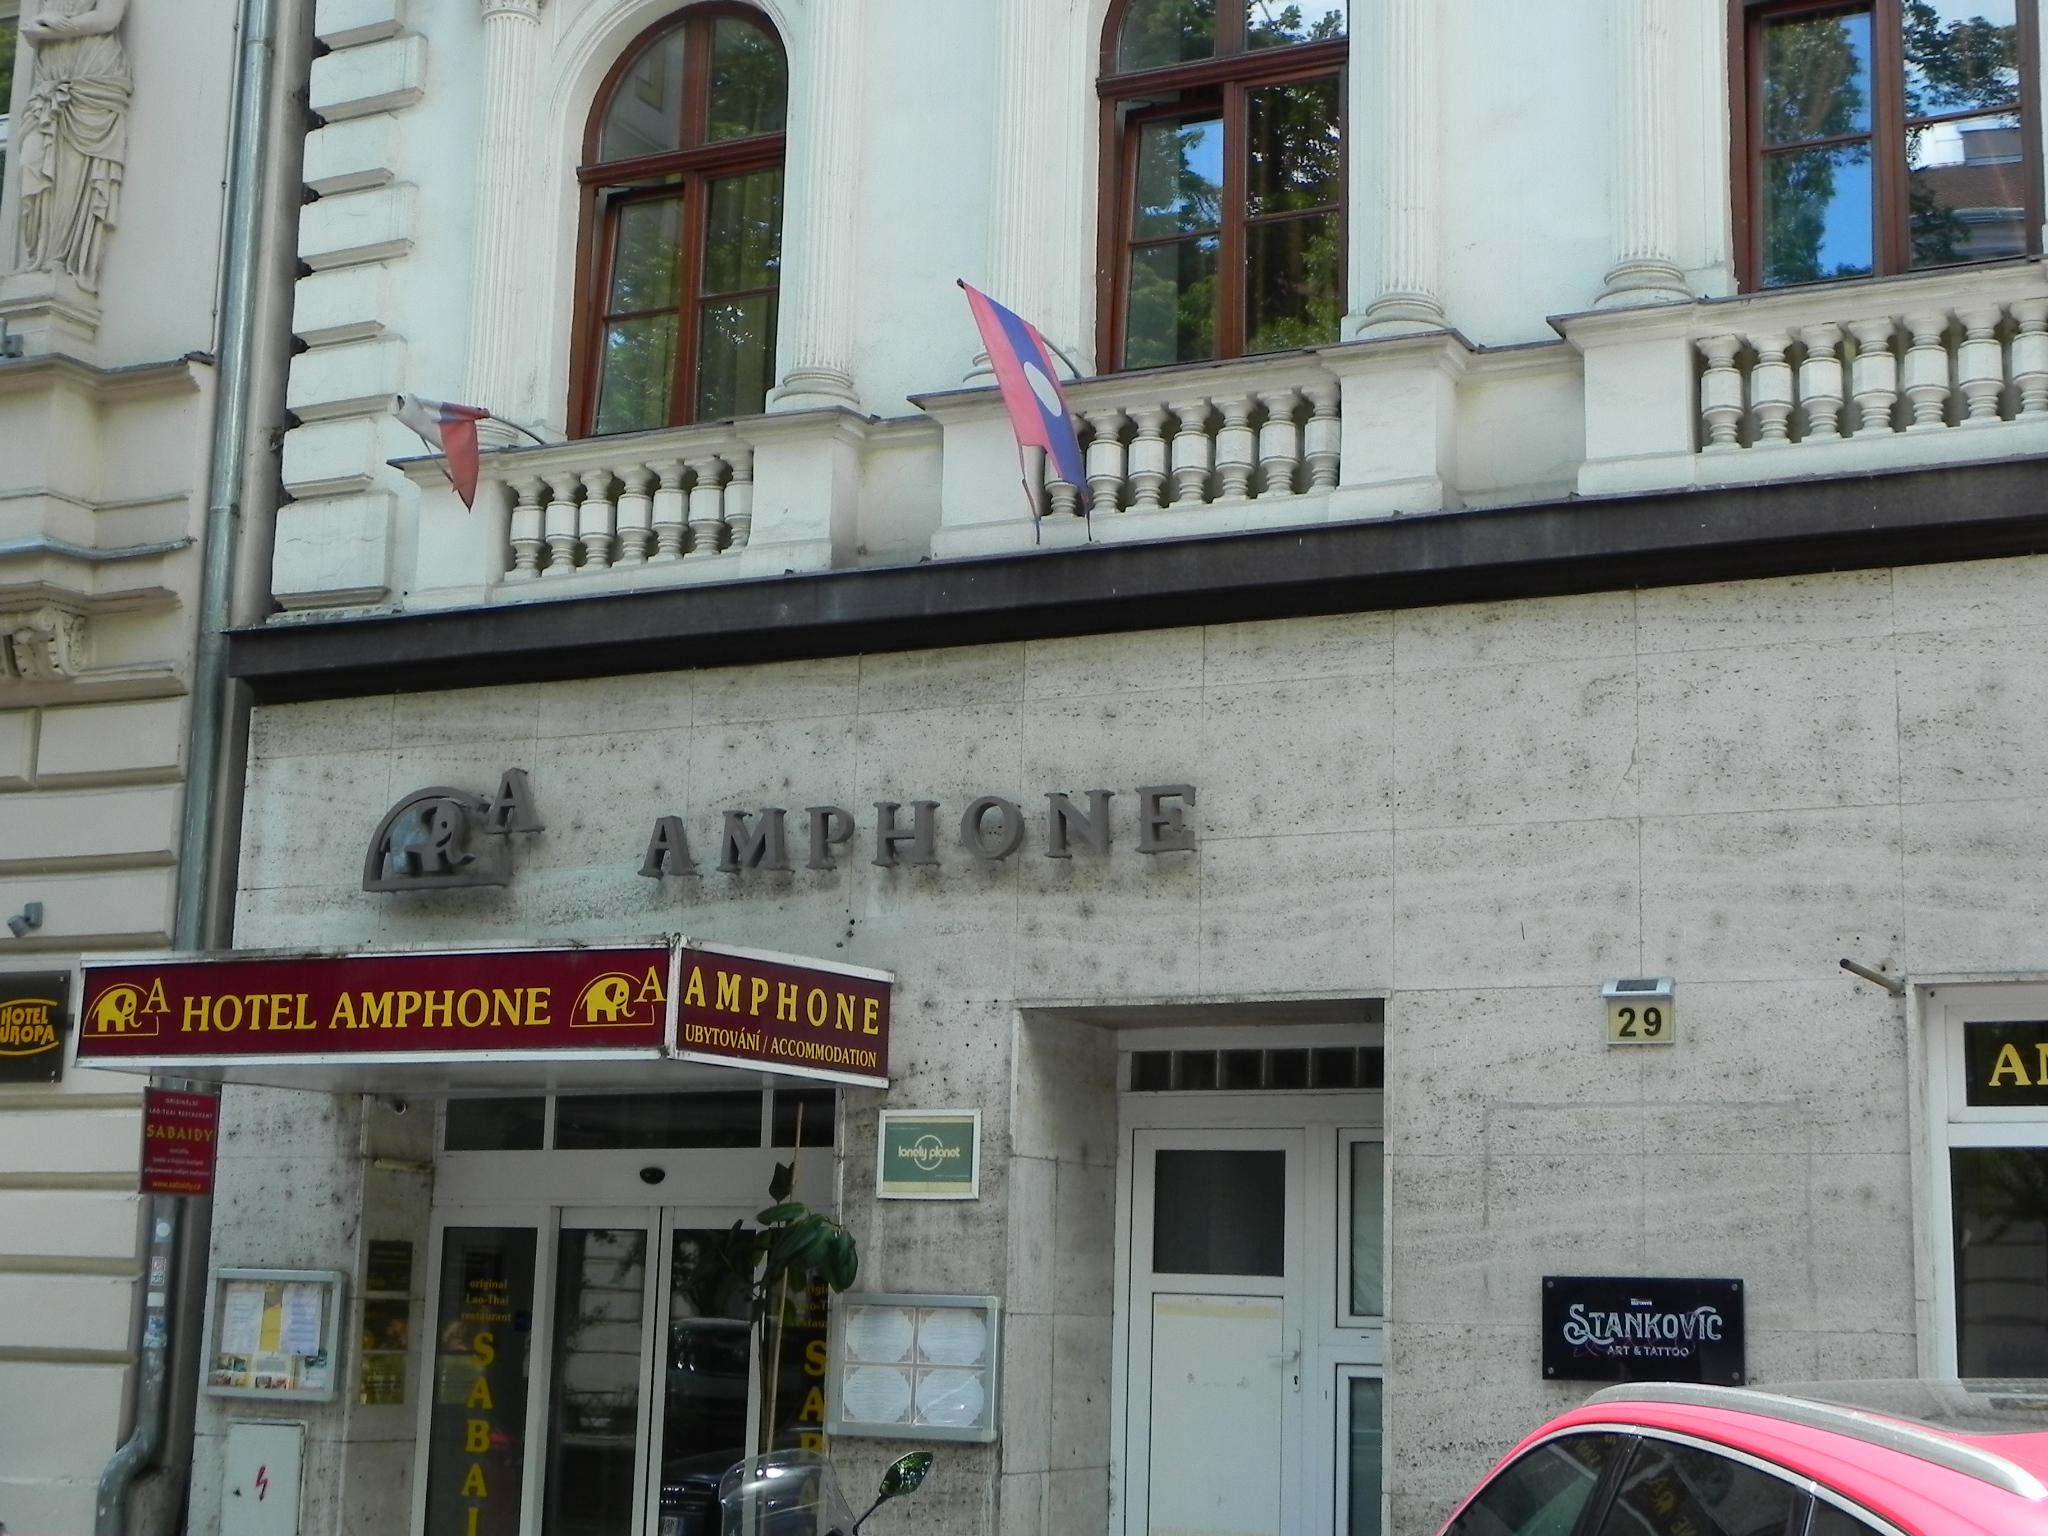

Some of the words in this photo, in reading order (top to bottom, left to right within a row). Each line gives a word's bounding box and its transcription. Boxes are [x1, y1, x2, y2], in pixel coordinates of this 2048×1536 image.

[637, 784, 1197, 879] AMPHONE
[181, 993, 318, 1032] HOTEL
[328, 986, 551, 1029] AMPHONE
[684, 965, 880, 1036] AMPHONE
[1, 1005, 49, 1026] HOTEL
[1618, 1007, 1662, 1037] 29
[685, 1023, 761, 1051] UBYTOVÁNÍ
[762, 1035, 769, 1054] /
[770, 1037, 878, 1068] ACCOMMODATION
[146, 1123, 214, 1142] SABAIDY
[897, 1145, 928, 1162] lonely
[929, 1145, 961, 1161] planet
[469, 1278, 508, 1292] original
[465, 1293, 510, 1306] Lao-Thai
[461, 1311, 512, 1322] restaurant
[1607, 1345, 1630, 1357] ART
[1633, 1345, 1642, 1357] &
[1643, 1345, 1690, 1358] TATTOO
